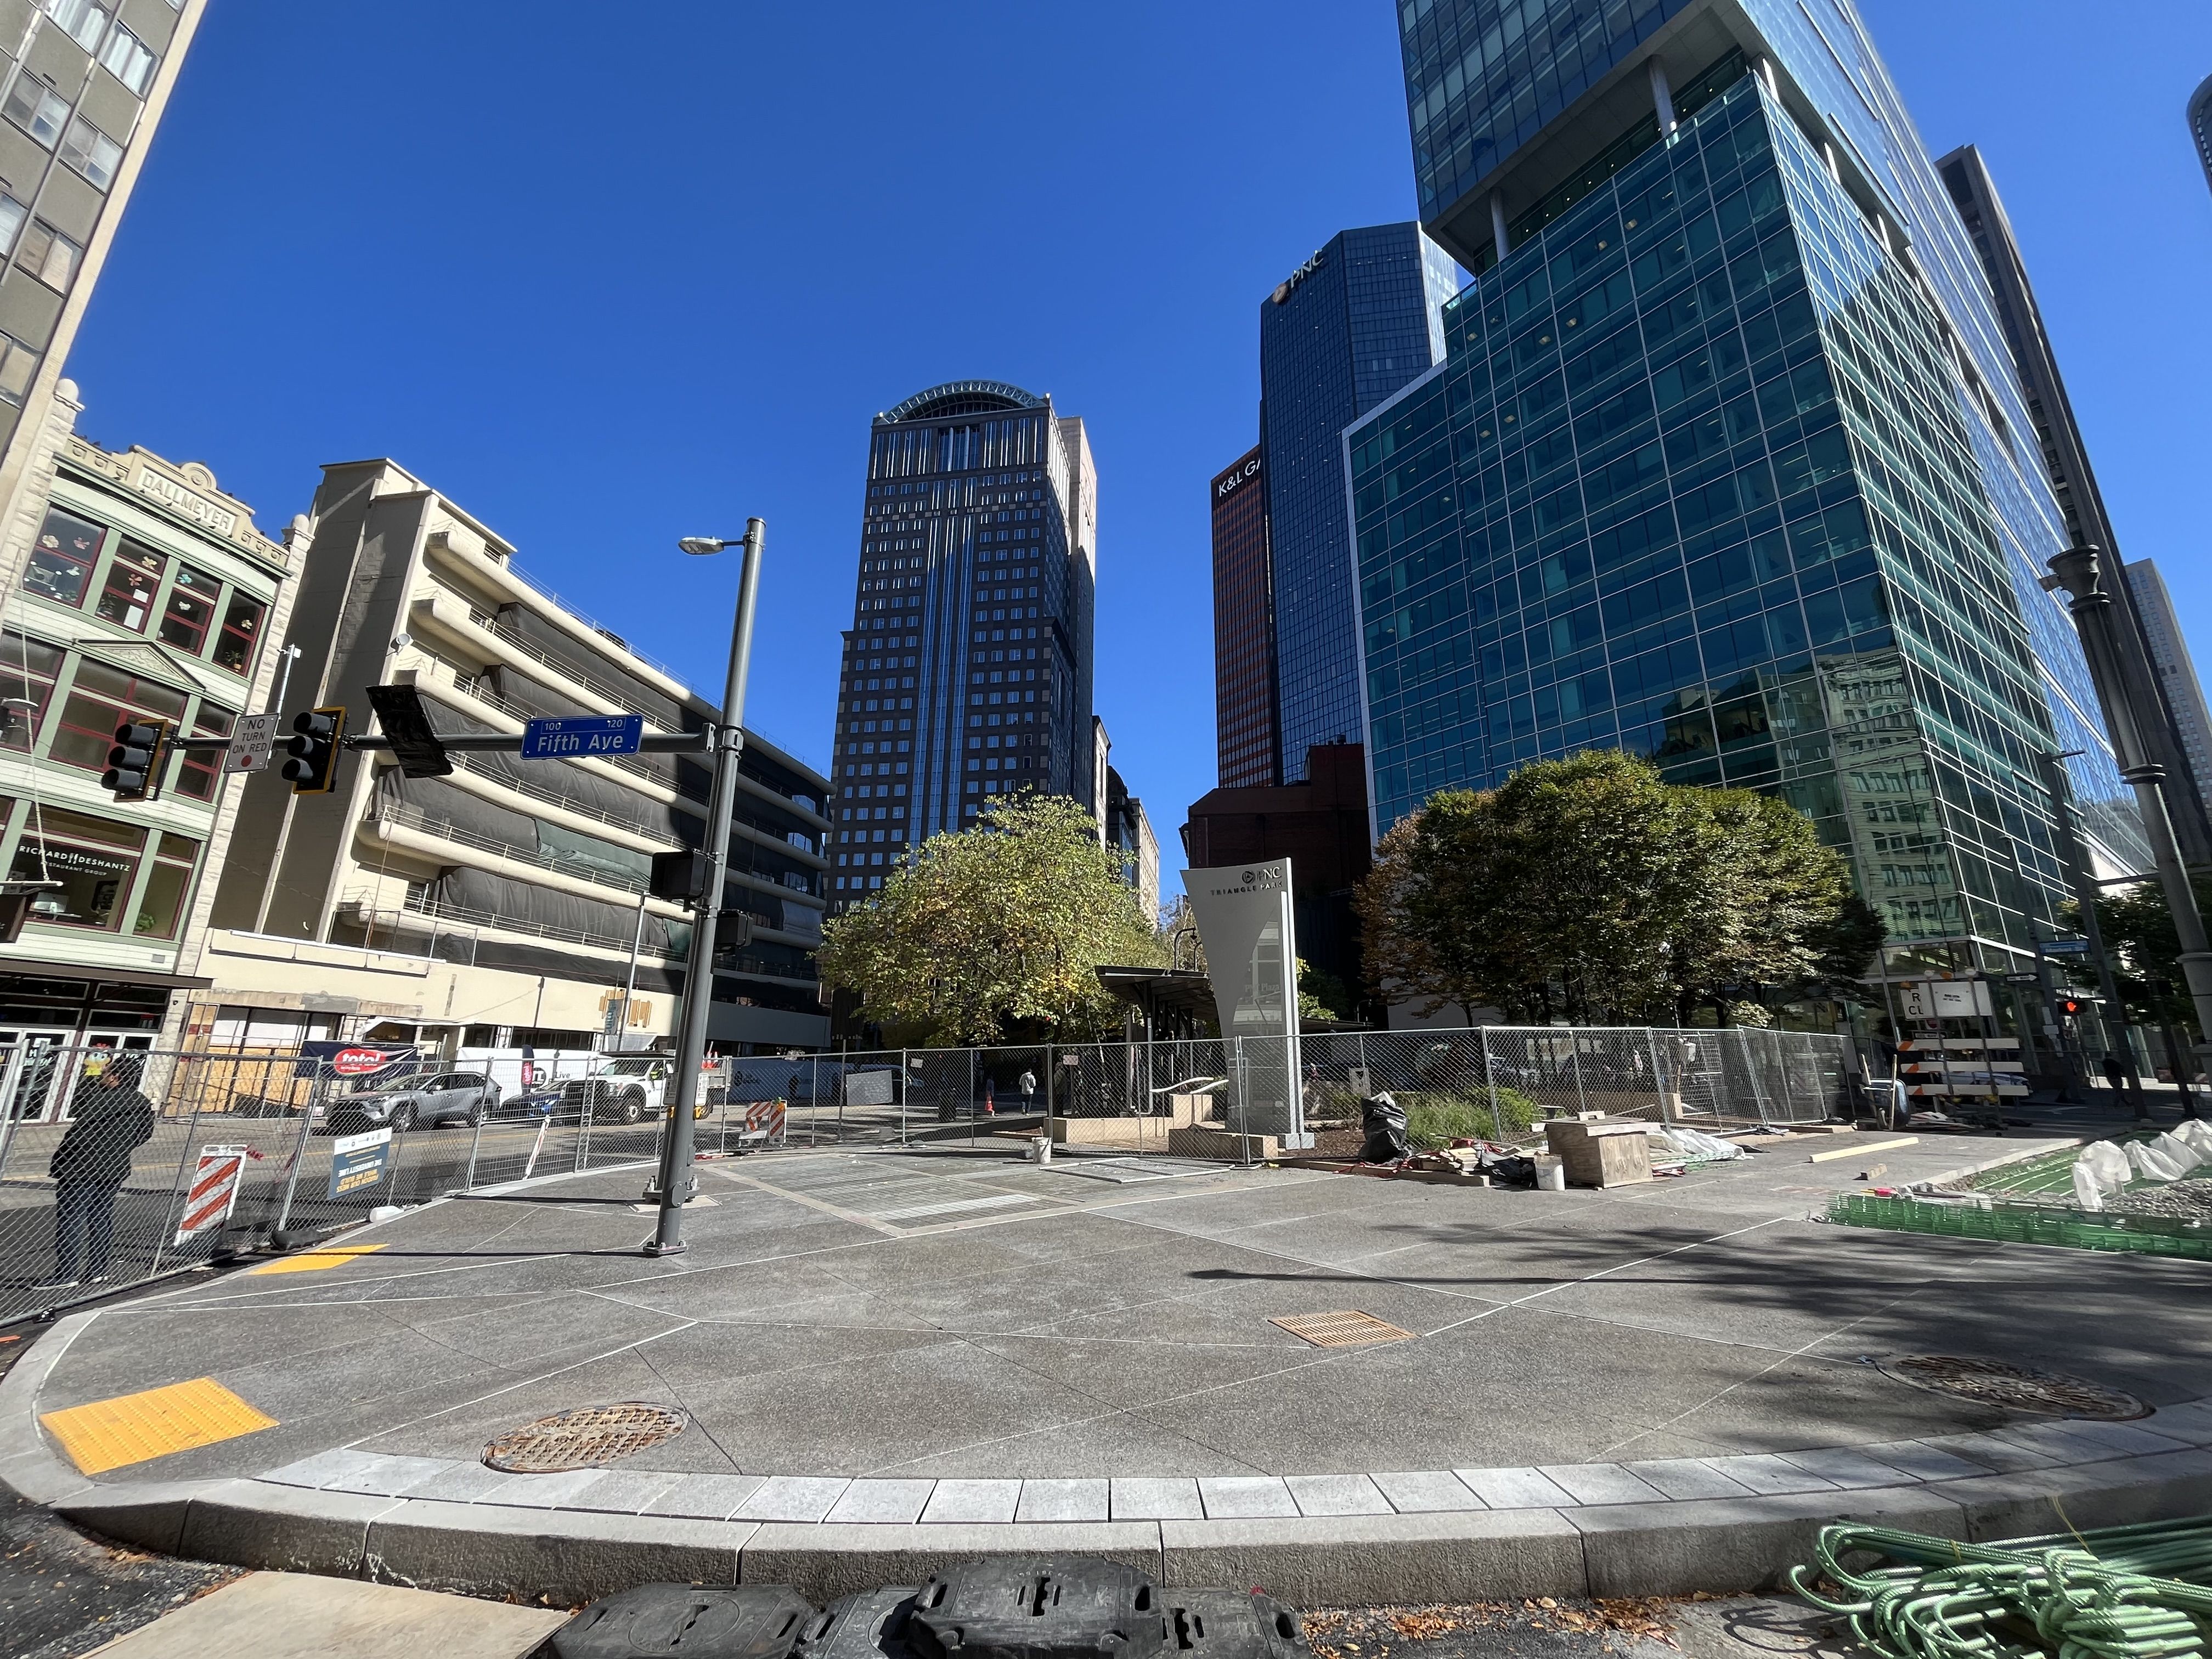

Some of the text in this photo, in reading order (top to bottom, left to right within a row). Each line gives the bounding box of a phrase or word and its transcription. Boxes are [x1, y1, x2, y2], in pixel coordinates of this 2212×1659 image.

[1290, 250, 1324, 289] PNC
[1218, 471, 1243, 498] K&L
[142, 472, 232, 529] DALLMEYER
[247, 719, 265, 730] NO
[545, 719, 623, 731] 100 120
[242, 731, 266, 742] TURN
[538, 734, 623, 752] Fifth Ave
[233, 743, 267, 754] ON RED
[78, 856, 131, 872] DESHANTZ
[1257, 866, 1283, 881] PNC
[1210, 881, 1283, 896] TRIANGLE PARK
